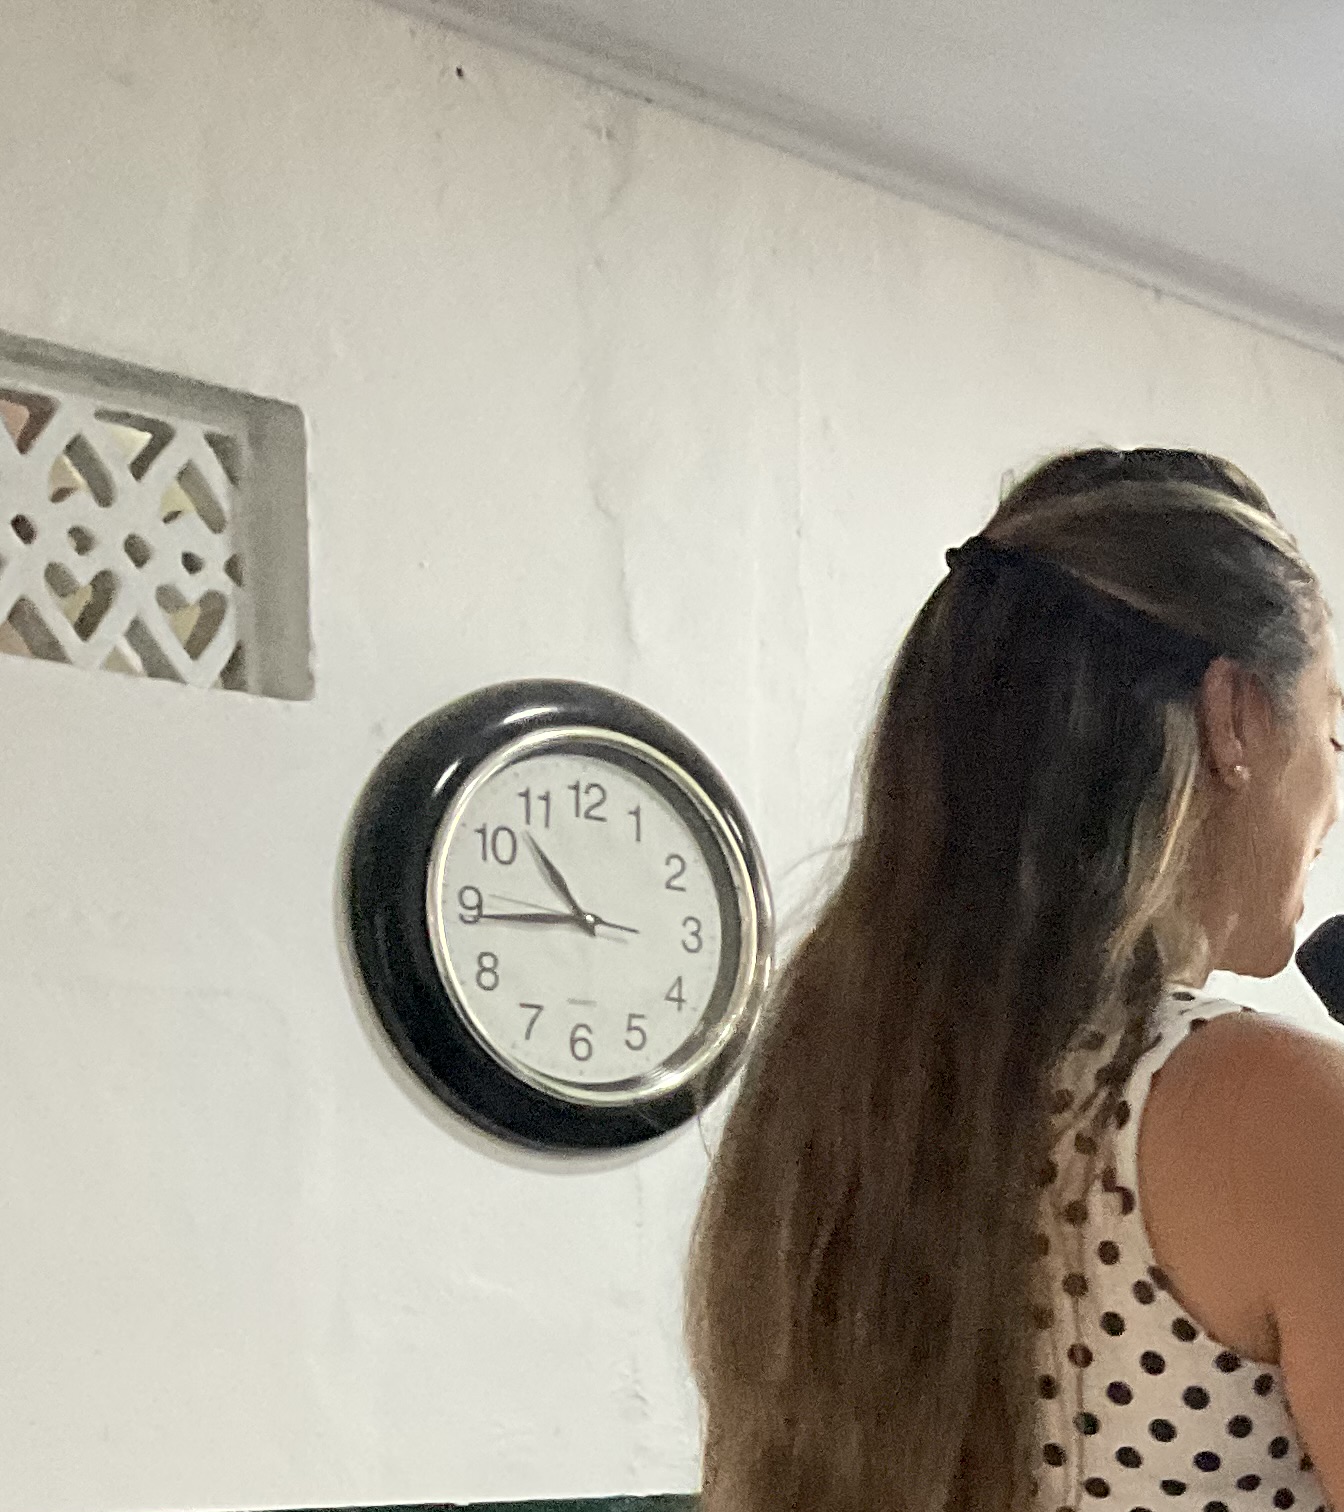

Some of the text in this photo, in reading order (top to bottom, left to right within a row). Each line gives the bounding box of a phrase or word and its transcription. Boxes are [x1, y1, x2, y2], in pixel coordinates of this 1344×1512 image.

[518, 787, 551, 828] 11
[568, 780, 608, 822] 12
[627, 806, 642, 842] 1
[474, 823, 518, 865] 10
[664, 854, 687, 892] 2
[457, 885, 483, 925] 9
[681, 916, 703, 954] 3
[475, 951, 500, 992] 8
[664, 975, 688, 1012] 4
[519, 1002, 545, 1040] 7
[623, 1013, 648, 1051] 5
[568, 1022, 594, 1062] 6
